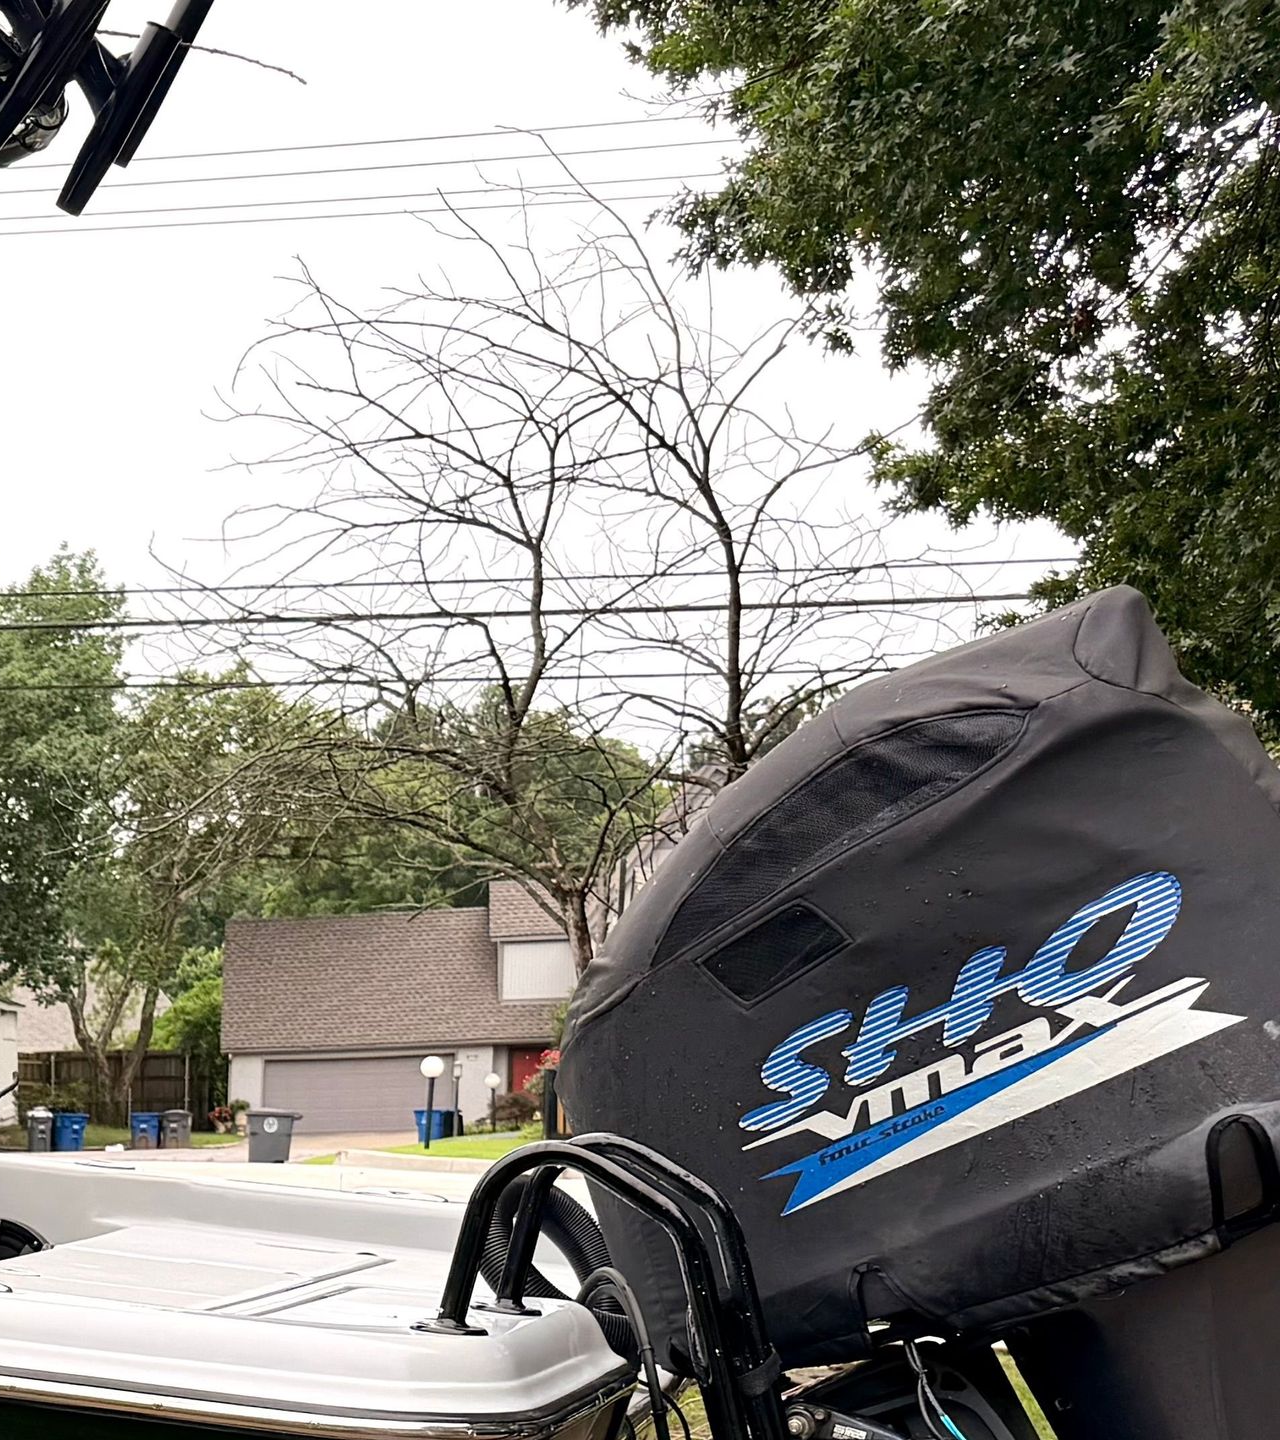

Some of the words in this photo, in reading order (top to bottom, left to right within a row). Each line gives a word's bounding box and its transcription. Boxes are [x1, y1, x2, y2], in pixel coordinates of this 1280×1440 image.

[738, 870, 1182, 1132] SHO
[818, 1137, 871, 1166] four
[878, 1105, 945, 1138] stroke
